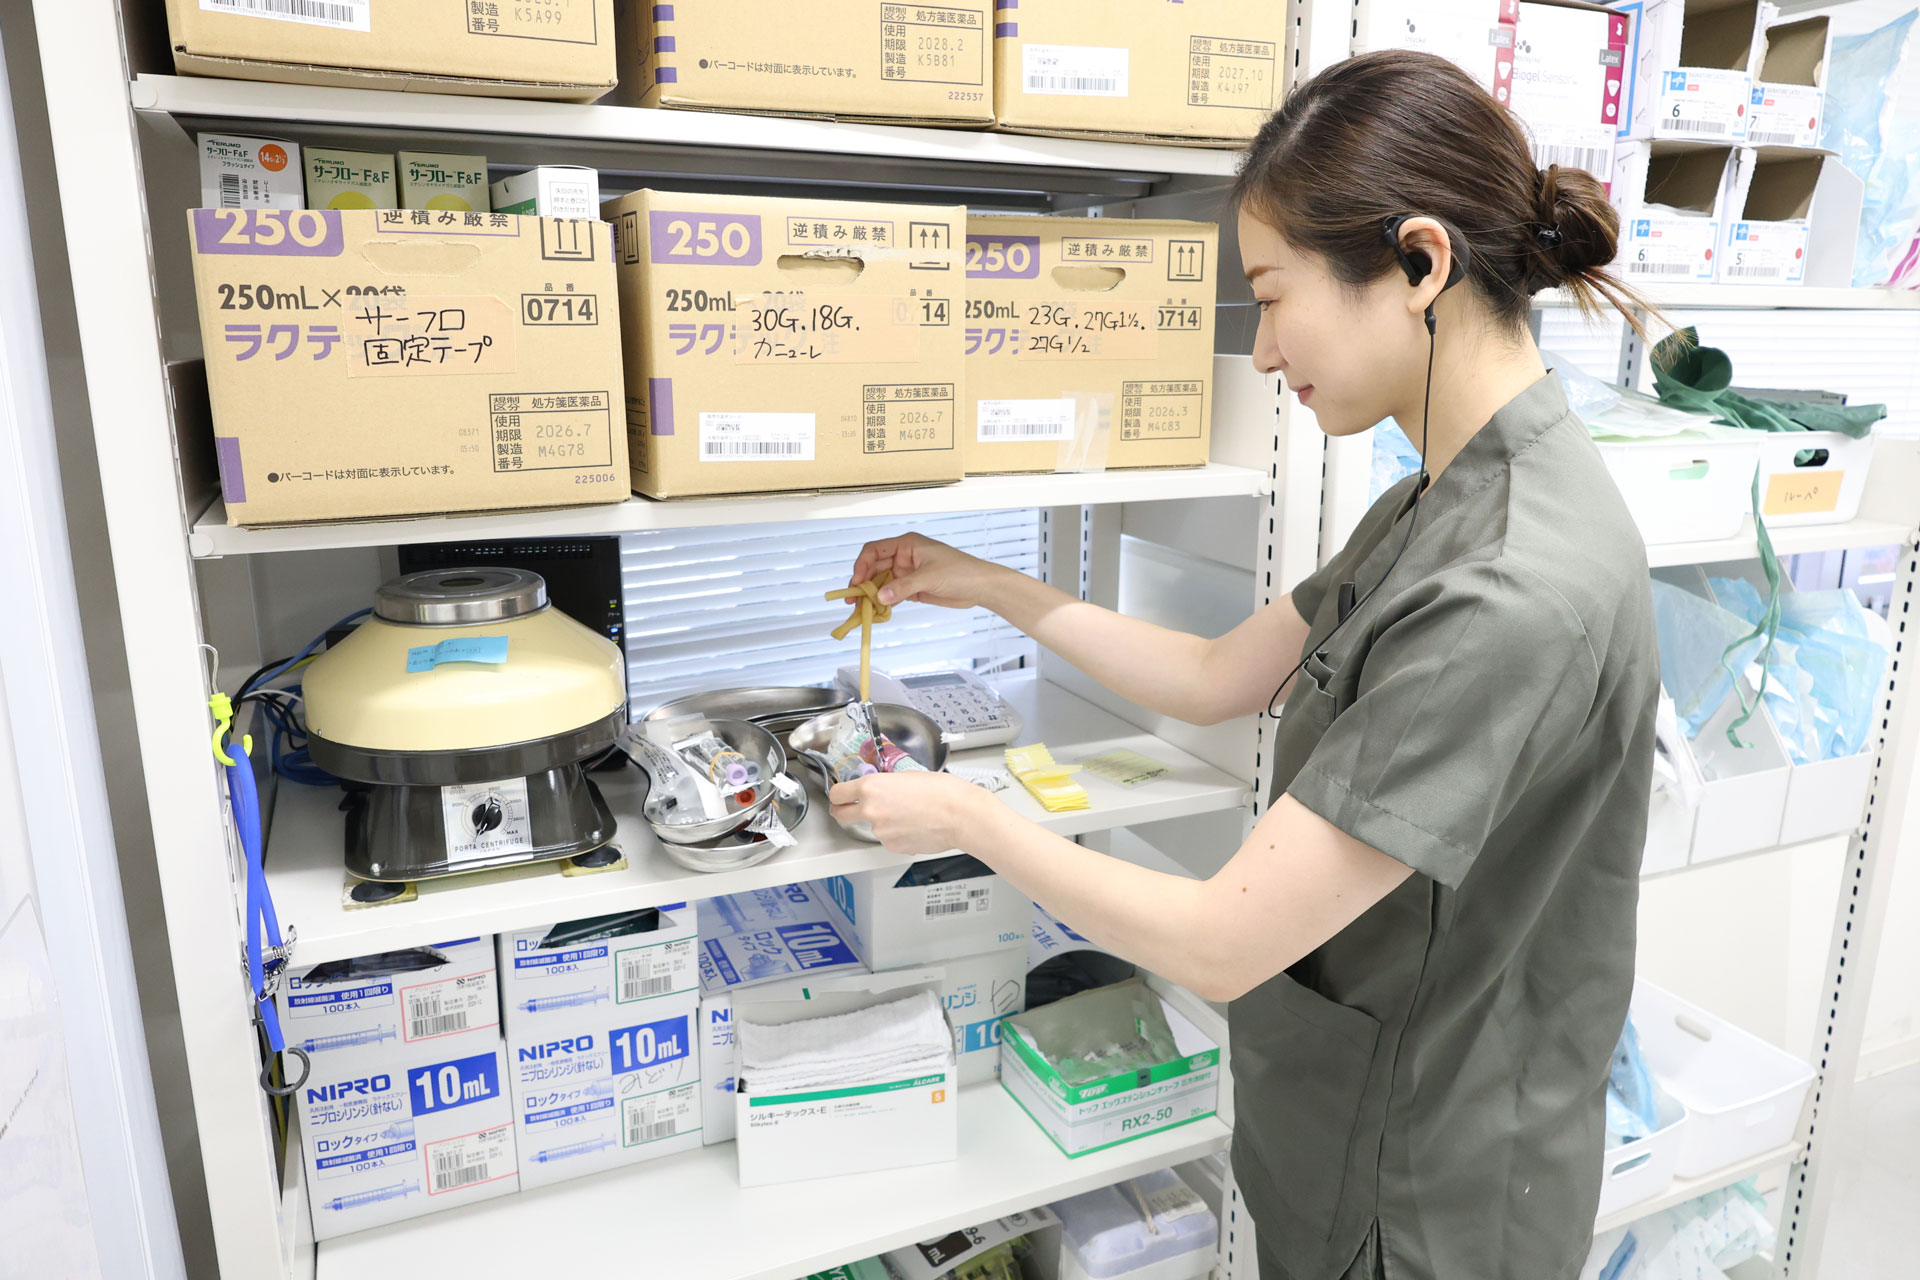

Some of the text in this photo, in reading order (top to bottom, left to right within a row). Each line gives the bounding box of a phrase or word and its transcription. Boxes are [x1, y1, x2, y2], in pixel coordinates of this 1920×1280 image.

[471, 0, 499, 17] 製造
[514, 7, 562, 25] K5A99
[472, 17, 500, 33] 番号
[884, 25, 906, 37] 使用
[884, 36, 964, 52] 期限 2028.2
[1490, 33, 1510, 45] Latex
[884, 52, 907, 65] 製造
[1192, 55, 1211, 67] 使用
[1601, 53, 1619, 64] Latex
[884, 65, 906, 79] 番号
[1191, 66, 1263, 81] 期限 2027.10
[1512, 67, 1540, 83] Biogel
[1191, 80, 1210, 92] 製造
[948, 91, 984, 102] 222537
[1190, 92, 1209, 104] 番号
[1671, 103, 1681, 118] 6
[211, 140, 241, 148] TERUMO
[317, 158, 344, 166] TERUMO
[218, 210, 329, 248] 250
[793, 222, 887, 242] 逆積み厳禁
[667, 220, 752, 258] 250
[1067, 242, 1149, 258] 逆積み厳禁
[966, 242, 1031, 274] 250
[526, 298, 594, 322] 0714
[363, 335, 493, 368] 固定テープ
[754, 338, 823, 360] カニューレ
[894, 387, 949, 399] 処方箋医薬品
[532, 395, 602, 410] 処方箋医薬品
[866, 403, 886, 415] 使用
[1124, 397, 1142, 407] 使用
[866, 410, 944, 427] 期限 2026.7
[1124, 406, 1188, 417] 期限 2026.3
[494, 415, 521, 428] 使用
[1124, 418, 1180, 432] 製造 M4C83
[495, 423, 592, 442] 期限 2026.7
[866, 428, 936, 441] 製造 M4G78
[1123, 428, 1141, 439] 番号
[496, 442, 585, 458] 製造 M4G78
[866, 440, 886, 452] 番号
[497, 456, 524, 470] 番号
[575, 473, 616, 484] 225006
[454, 837, 524, 853] PORTA CENTRIFUGE
[753, 931, 784, 955] ロック
[781, 923, 841, 970] 10mL
[562, 948, 605, 963] 使用1回限り
[545, 964, 579, 975] 100本入
[340, 985, 390, 1001] 使用1回限り
[322, 1002, 360, 1015] 100本入
[518, 1034, 594, 1062] NIPRO
[616, 1026, 682, 1069] 10mL
[619, 1057, 685, 1095] みどり
[307, 1073, 391, 1105] NIPRO
[415, 1064, 490, 1111] 10mL
[311, 1098, 403, 1126] ニプロシリンジ(針なし)
[570, 1098, 612, 1115] 使用1回限り
[554, 1115, 587, 1128] 100本入
[1121, 1106, 1173, 1132] RX2-50
[366, 1142, 413, 1159] 使用1回限り
[350, 1159, 386, 1173] 100本入
[927, 1247, 946, 1265] mL
